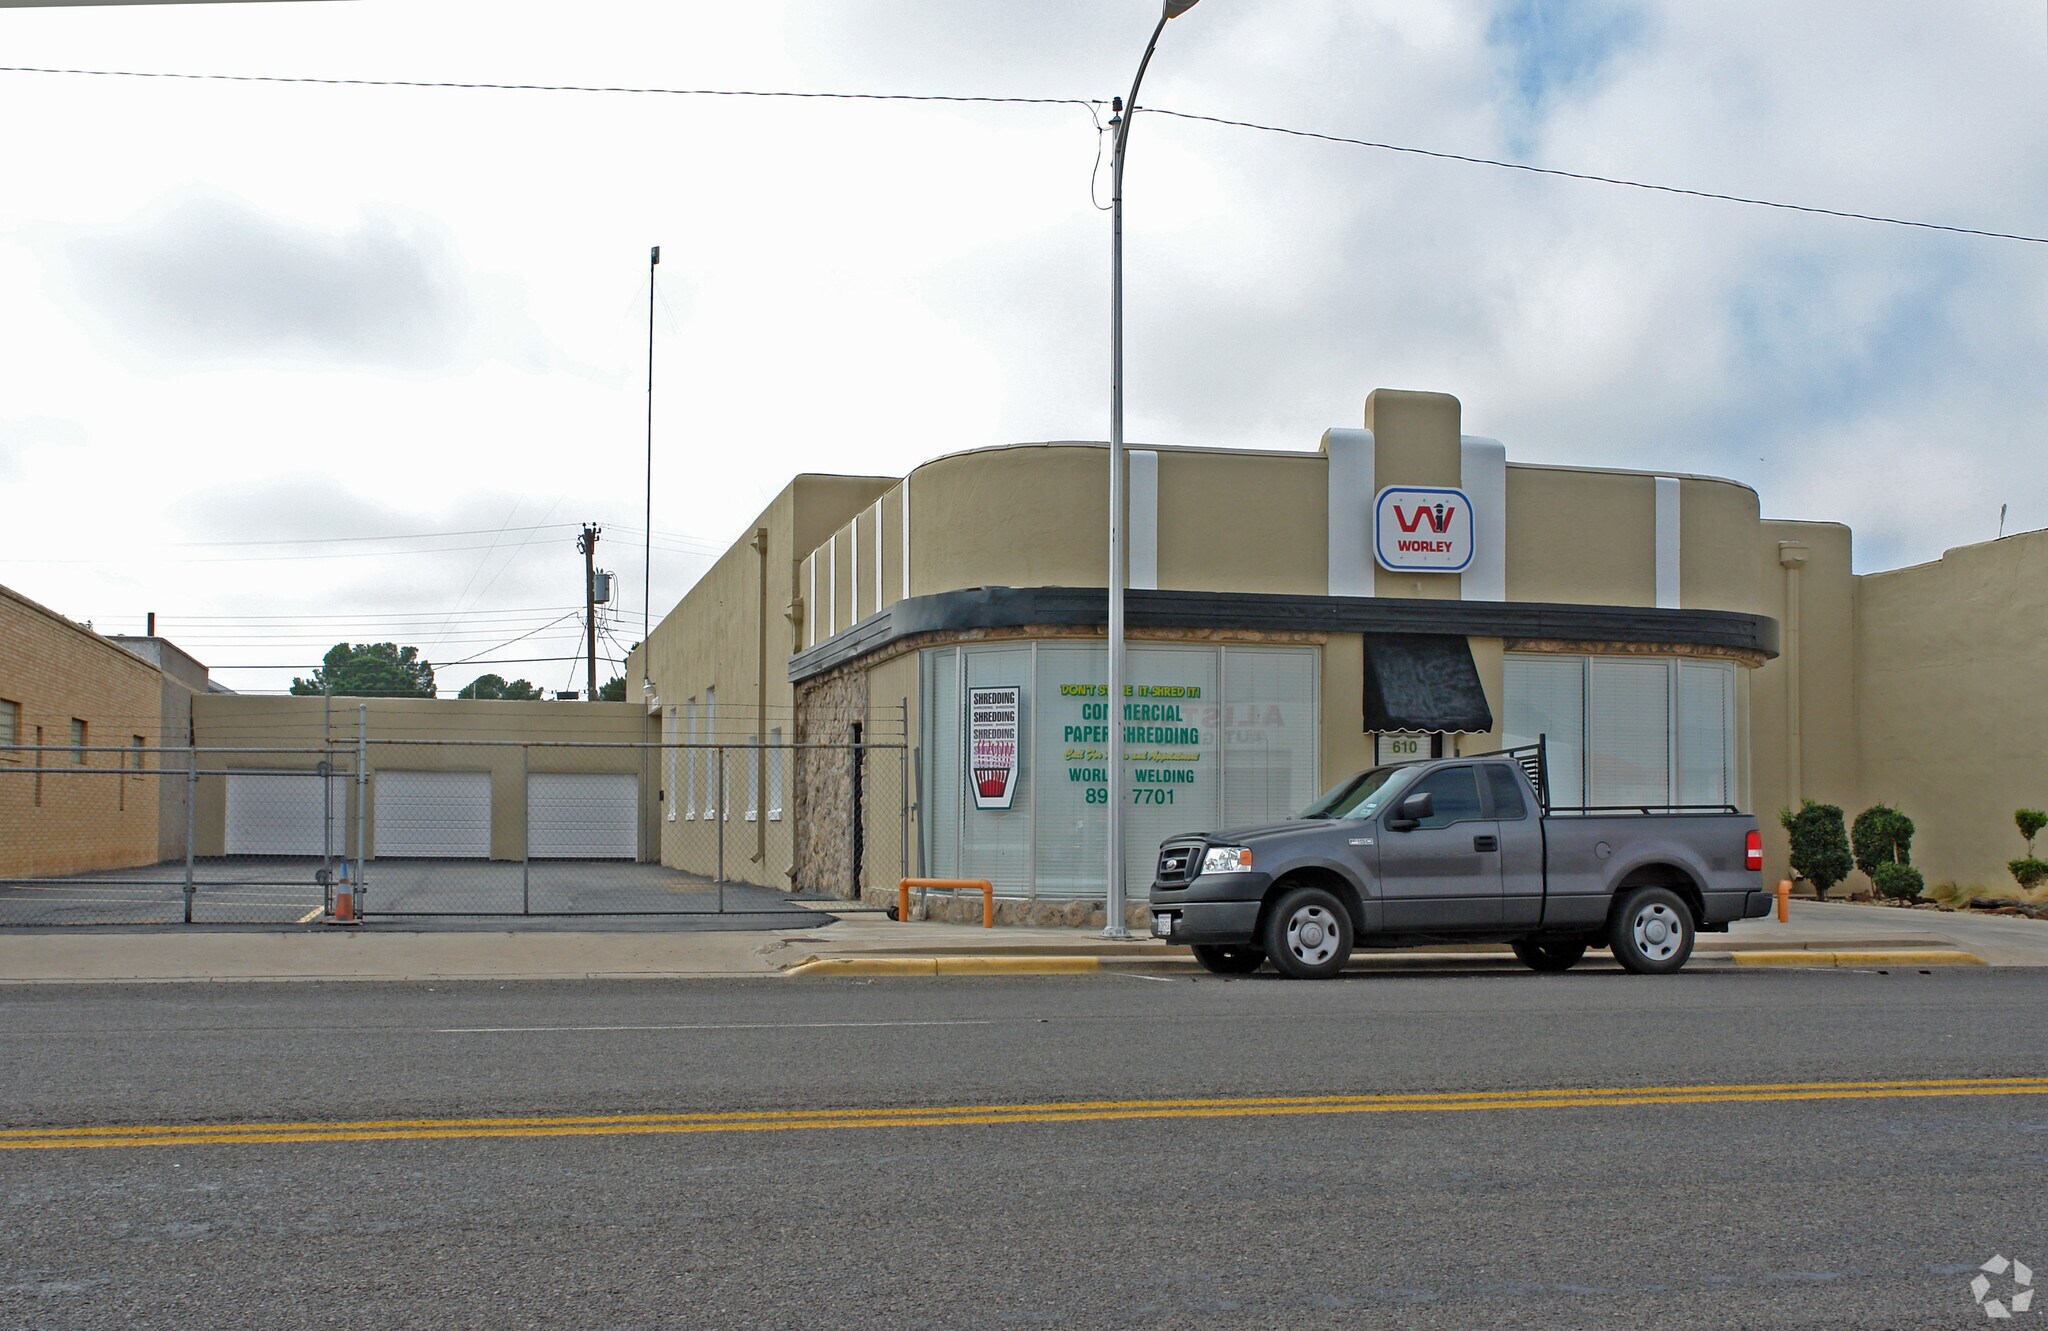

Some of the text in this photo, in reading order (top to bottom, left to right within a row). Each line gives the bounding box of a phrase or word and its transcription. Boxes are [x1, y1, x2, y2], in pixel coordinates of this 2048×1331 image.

[1397, 540, 1453, 553] WORLEY
[1060, 684, 1096, 696] DON'T
[973, 692, 1015, 705] SHREDDING
[973, 711, 1015, 723] SHREDDING
[973, 728, 1015, 740] SHREDDING
[1123, 726, 1199, 744] HREDDING
[1392, 740, 1418, 754] 610
[1134, 768, 1194, 783] WELDING
